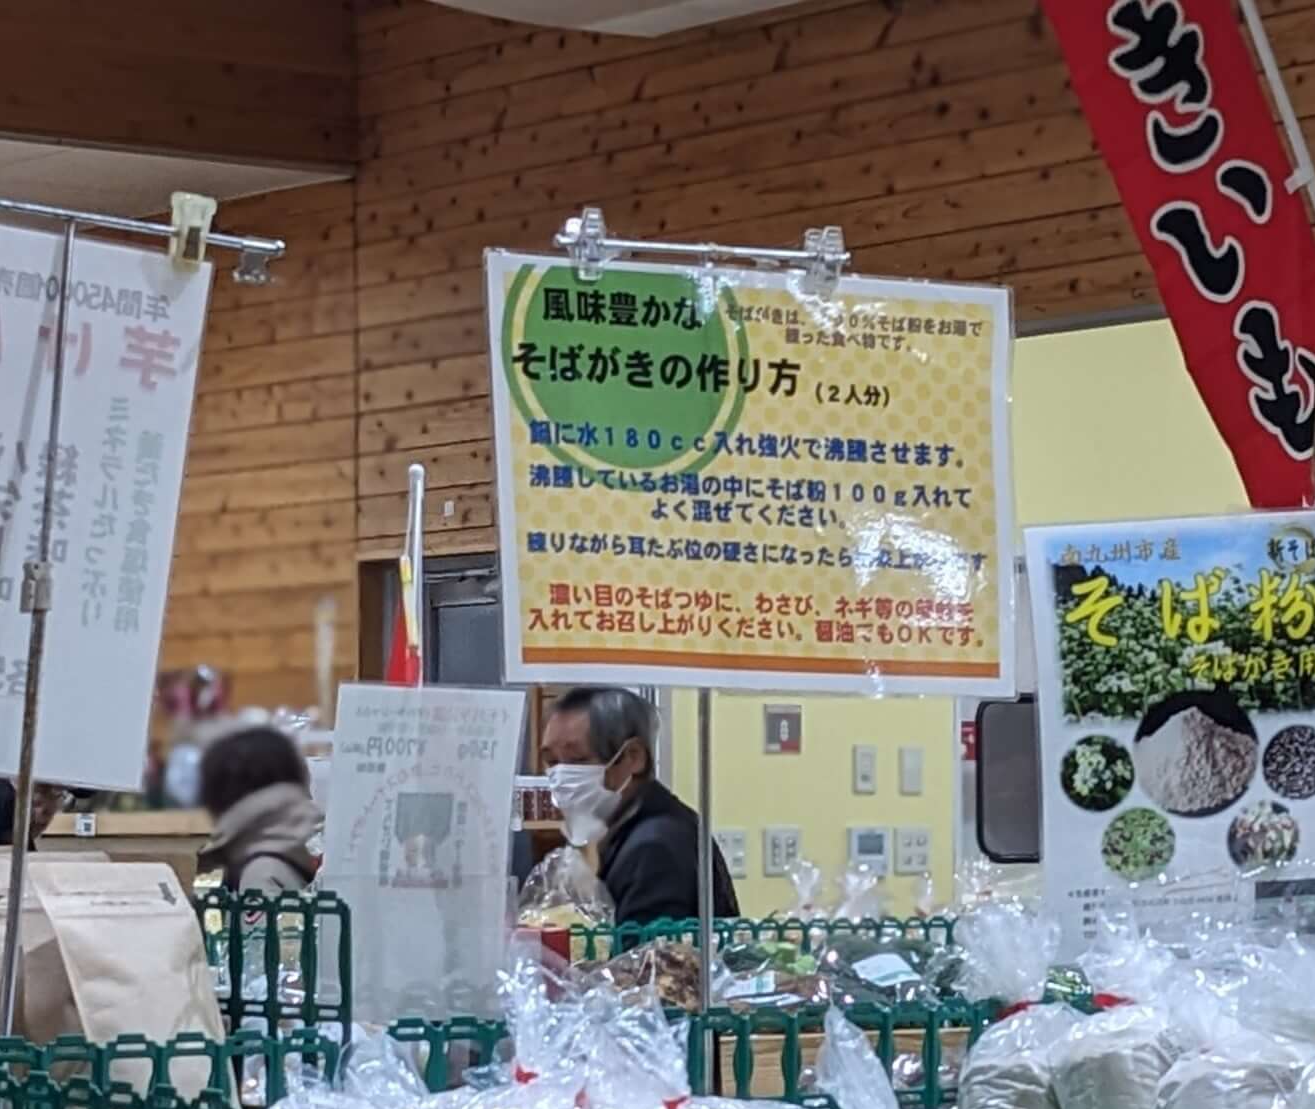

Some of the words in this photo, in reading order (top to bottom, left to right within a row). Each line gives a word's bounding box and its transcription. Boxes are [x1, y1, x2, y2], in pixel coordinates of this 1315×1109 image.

[542, 287, 703, 331] 風味豊かな
[511, 342, 801, 398] そばがきの作り方
[651, 499, 846, 530] よく混ぜてください。
